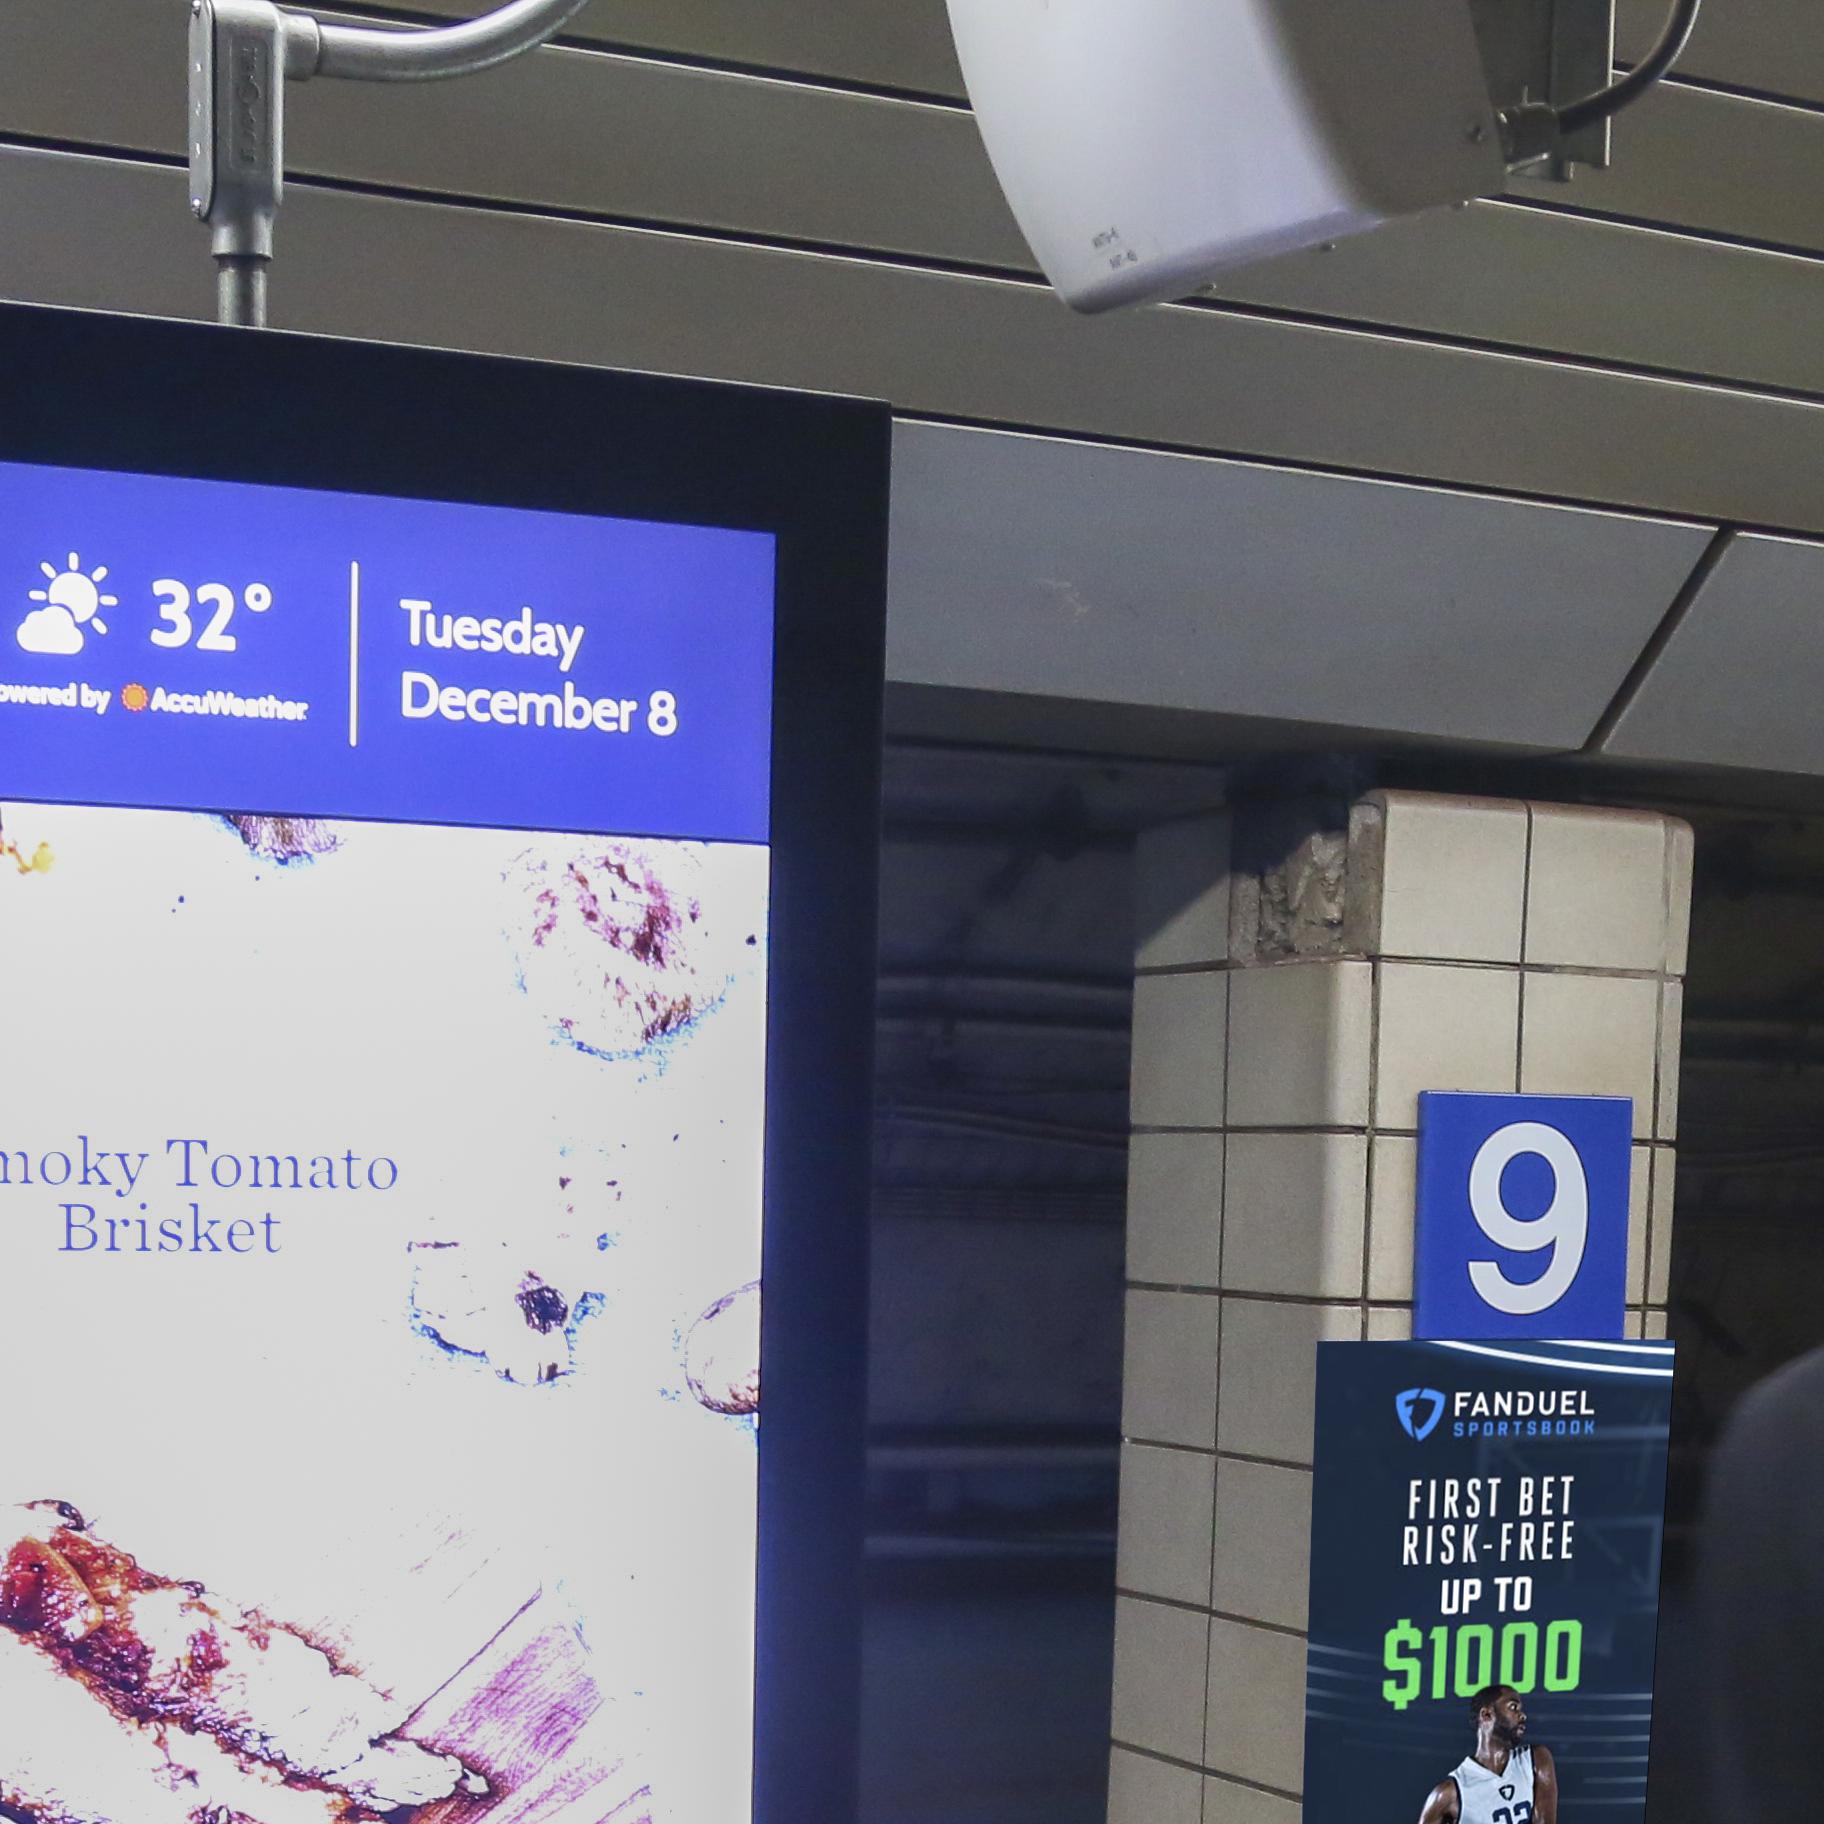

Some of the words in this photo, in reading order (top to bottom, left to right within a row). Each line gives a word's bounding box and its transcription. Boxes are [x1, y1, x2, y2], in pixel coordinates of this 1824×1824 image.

[150, 579, 272, 652] 32°
[399, 598, 584, 672] Tuesday
[80, 683, 111, 715] by
[150, 687, 309, 720] AccuWeather
[401, 671, 637, 733] December
[646, 690, 678, 736] 8
[165, 1139, 398, 1190] Tomato
[58, 1202, 282, 1253] Brisket
[1467, 1121, 1589, 1315] 9
[1453, 1390, 1595, 1416] FANDUEL
[1453, 1420, 1595, 1438] SPORTSBOOK
[1408, 1478, 1502, 1520] FIRST
[1518, 1475, 1575, 1517] BET
[1402, 1520, 1575, 1566] RISK-FREE
[1440, 1578, 1481, 1615] UP
[1494, 1576, 1532, 1612] TO
[1382, 1618, 1583, 1711] $1000
